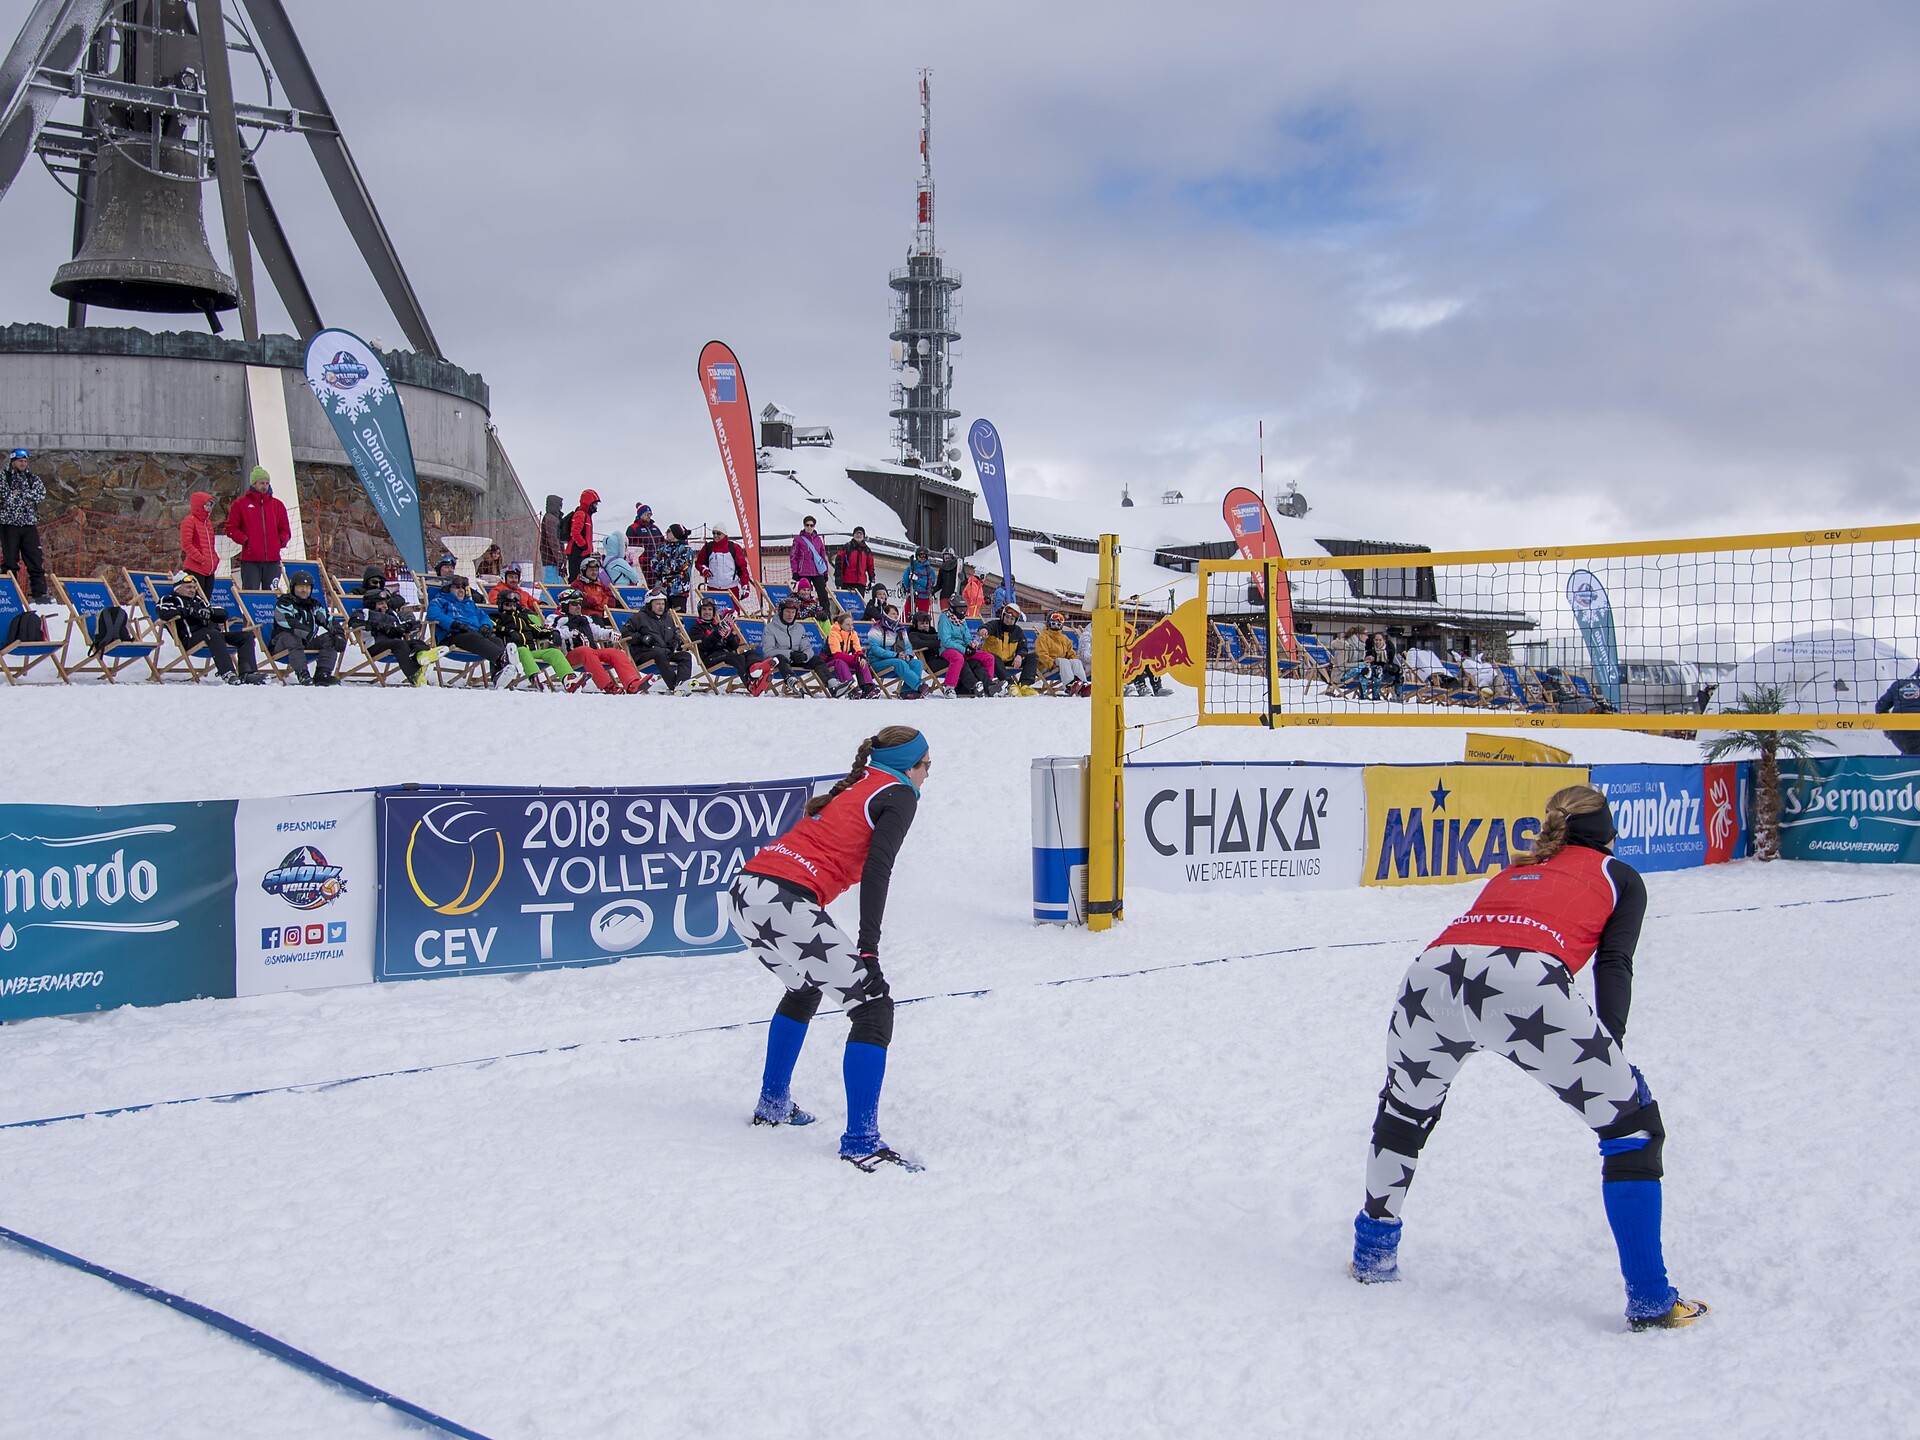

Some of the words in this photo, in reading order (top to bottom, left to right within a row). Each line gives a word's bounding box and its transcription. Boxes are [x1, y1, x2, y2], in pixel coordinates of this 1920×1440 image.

[1823, 532, 1842, 540] CEV
[1530, 719, 1545, 727] CEV
[1836, 720, 1854, 729] CEV
[276, 820, 338, 833] #BEASNOWER
[522, 800, 610, 848] 2018
[621, 792, 792, 845] SNOW
[1592, 782, 1701, 854] ronplatz
[1667, 843, 1676, 852] DE
[1677, 841, 1704, 851] CORONES
[264, 864, 342, 883] SNOW
[522, 847, 760, 897] VOLLEYBA
[1185, 863, 1209, 882] WE
[1211, 860, 1258, 880] CREATE
[1262, 857, 1321, 878] FEELINGS
[0, 848, 158, 914] nardo
[282, 882, 323, 894] VOLLEY
[520, 892, 730, 959] TOU
[414, 927, 498, 967] CEV
[264, 949, 345, 965] @SNOWVOLLEYITALIA
